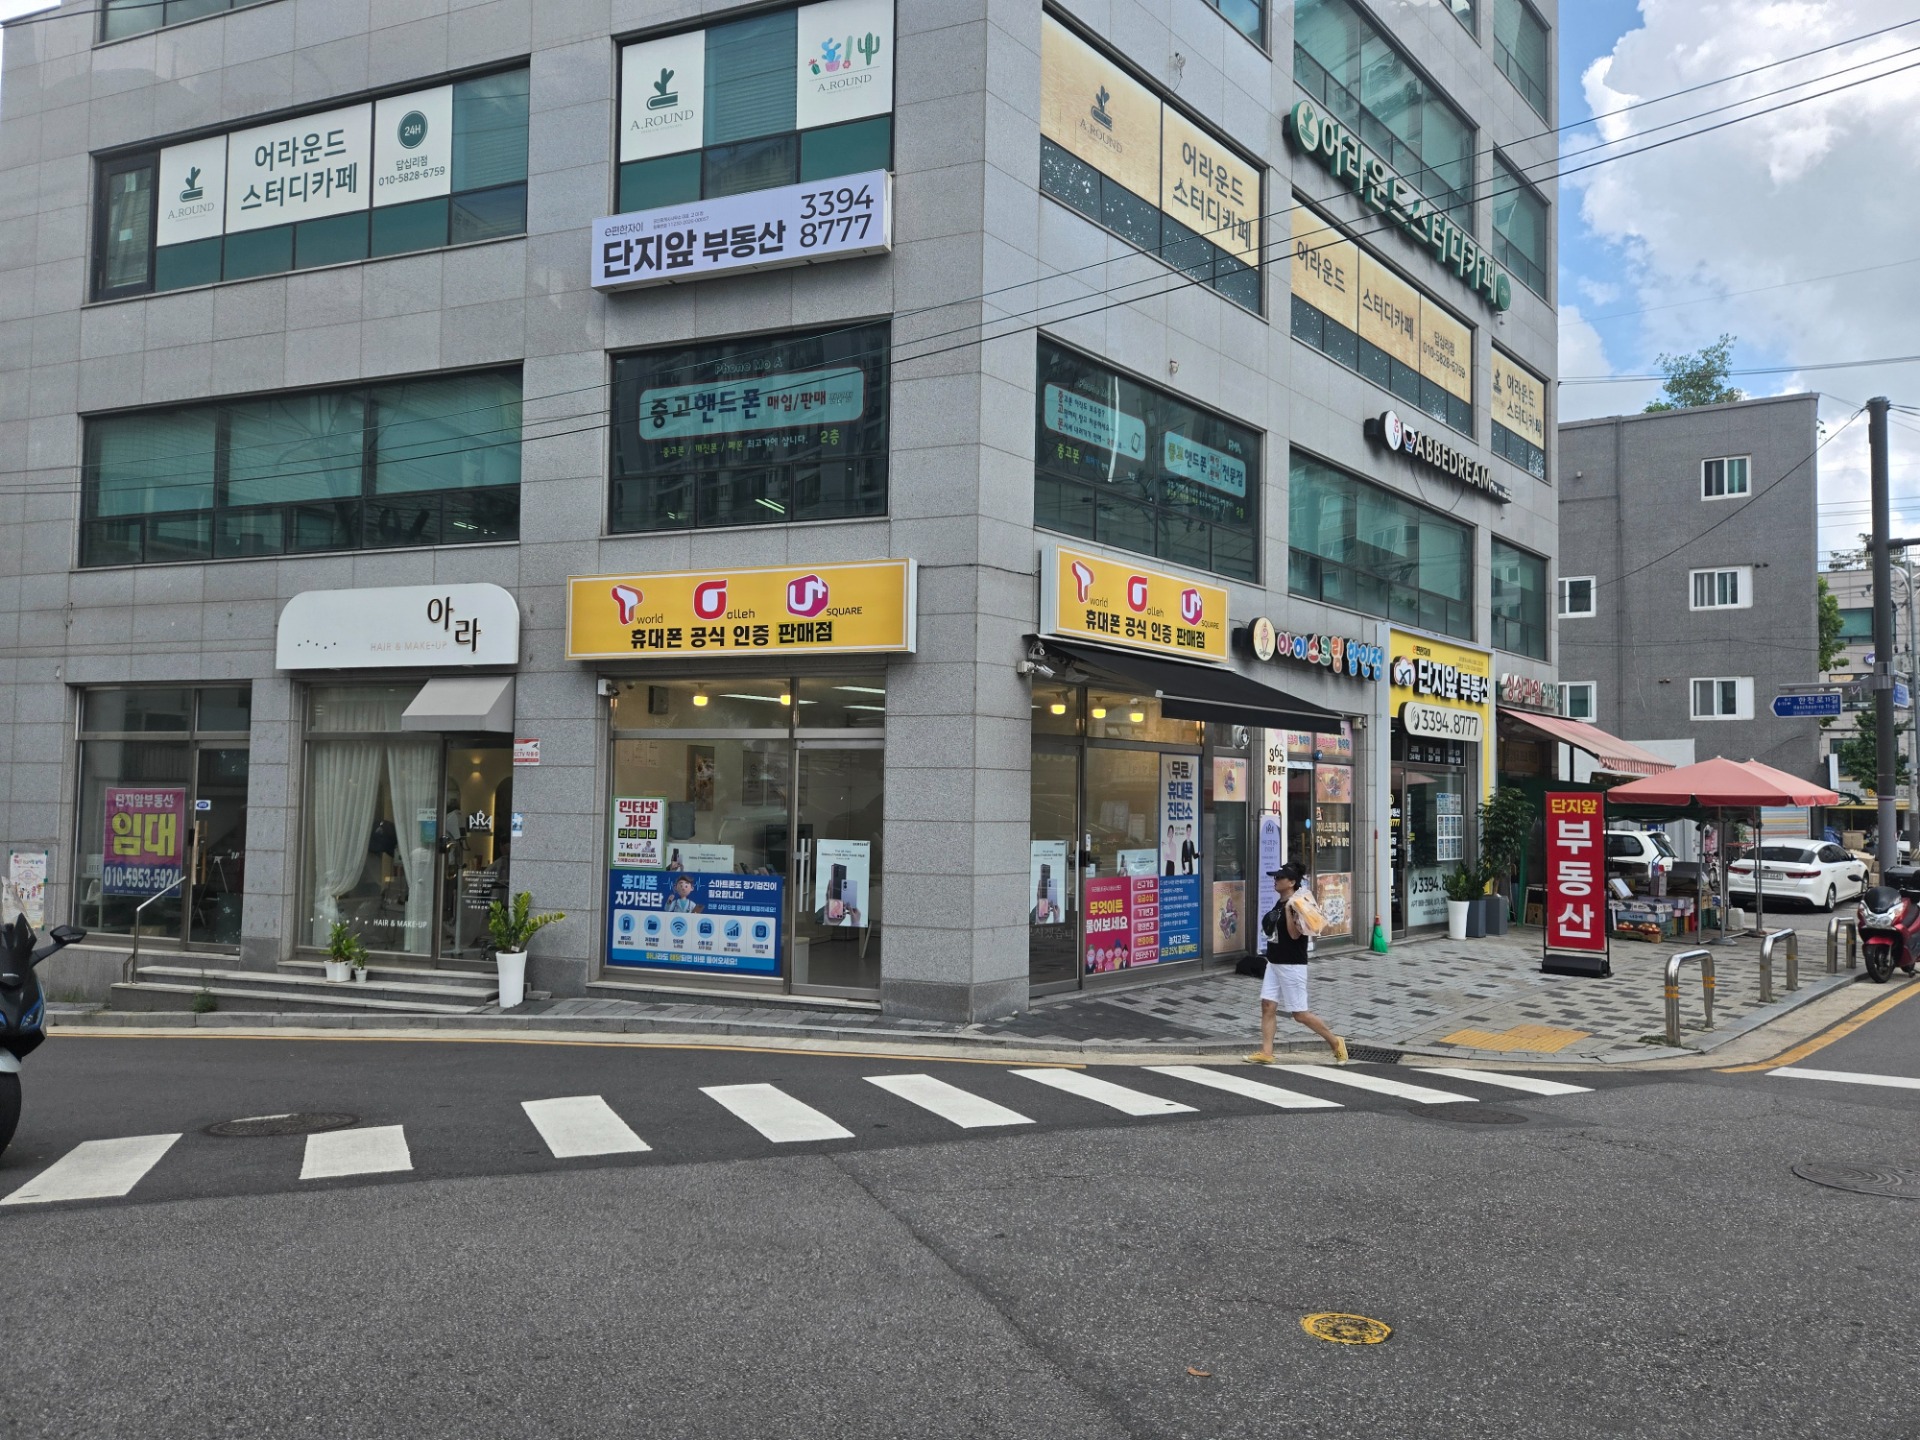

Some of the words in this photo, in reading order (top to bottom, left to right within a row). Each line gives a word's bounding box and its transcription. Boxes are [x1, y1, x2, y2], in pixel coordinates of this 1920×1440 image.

[817, 73, 872, 93] A.ROUND
[630, 109, 694, 131] A.ROUND
[404, 124, 421, 137] 24H
[1079, 118, 1123, 153] A.ROUND
[254, 129, 346, 172] 어라운드
[396, 156, 429, 172] 답십리점
[1182, 142, 1244, 206] 어라운드
[378, 166, 445, 186] 010-5828-6759
[241, 162, 358, 211] 스터디카페
[167, 202, 215, 220] A.ROUND
[801, 184, 874, 220] 3394
[1173, 178, 1251, 250] 스터디카페
[800, 213, 872, 248] 8777
[604, 228, 697, 278] 단지앞
[703, 220, 786, 262] 부동산
[1297, 240, 1346, 293] 어라운드
[1362, 287, 1414, 341] 스터디카페
[651, 387, 761, 428] 중고핸드폰
[767, 390, 826, 412] 매입/판매
[820, 429, 840, 446] 2층
[636, 613, 664, 625] world
[826, 606, 863, 617] SQUARE
[1089, 597, 1108, 607] world
[1201, 619, 1220, 630] SQUARE
[631, 628, 682, 650] 휴대폰
[690, 626, 725, 648] 공식
[733, 624, 769, 646] 인증
[778, 621, 833, 645] 판매점
[1086, 609, 1120, 635] 휴대폰
[1125, 616, 1147, 639] 공식
[1151, 622, 1172, 644] 인증
[1177, 627, 1205, 649] 판매점
[404, 640, 448, 651] MAKE-UP
[1277, 631, 1344, 673] 아이스크림
[1347, 638, 1385, 682] 할인점
[1418, 659, 1458, 699] 단지앞
[1460, 672, 1490, 704] 부동산
[1421, 709, 1478, 736] 3394.8777
[1269, 744, 1284, 762] 365
[1172, 761, 1189, 779] 무료
[1167, 780, 1193, 800] 휴대폰
[115, 793, 174, 809] 단지앞부동산
[619, 800, 658, 813] 인터넷
[1167, 801, 1193, 821] 진단소
[1551, 799, 1597, 814] 단지앞
[625, 815, 651, 827] 가입
[111, 812, 177, 857] 임대
[104, 866, 179, 889] 010-5953-5924
[622, 875, 658, 891] 휴대폰
[708, 880, 742, 890] 스마트폰도
[743, 881, 777, 891] 정기검진이
[1556, 819, 1595, 939] 부동산
[615, 891, 664, 907] 자가진단
[708, 889, 744, 900] 필요합니다!
[1090, 899, 1123, 915] 무엇이든
[373, 919, 389, 927] HAIR
[396, 919, 427, 929] MAKE-UP
[1086, 916, 1128, 934] 물어보세요
